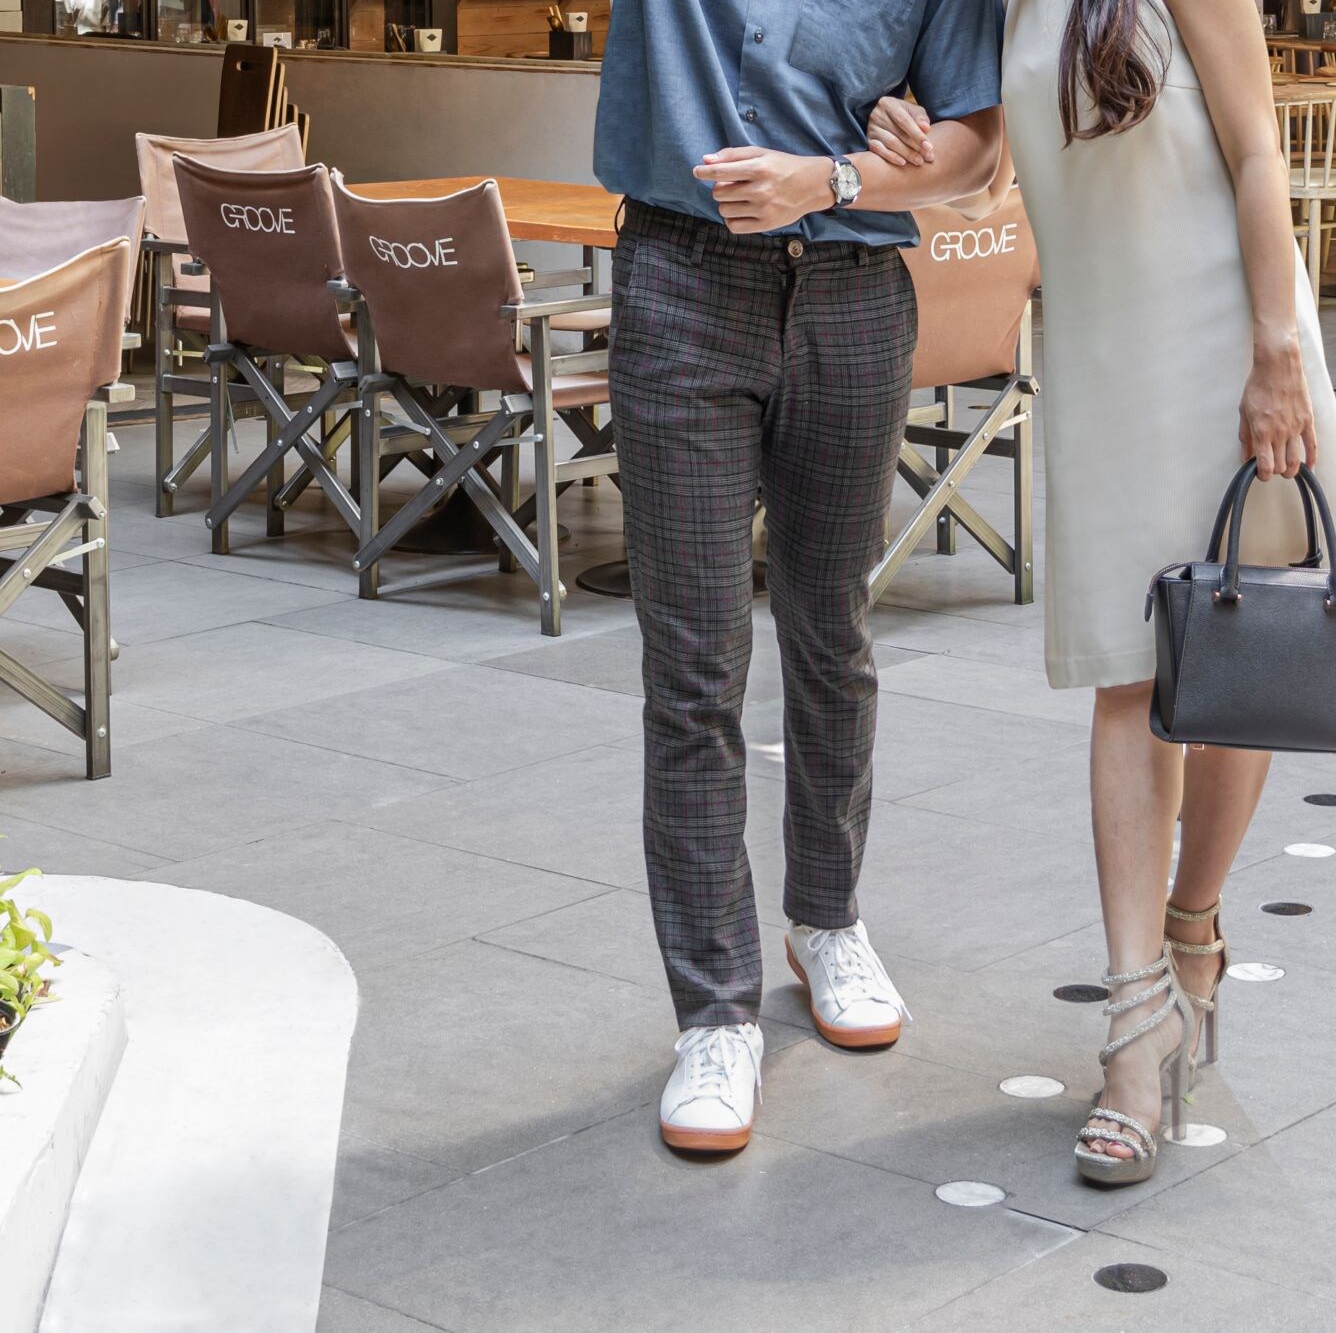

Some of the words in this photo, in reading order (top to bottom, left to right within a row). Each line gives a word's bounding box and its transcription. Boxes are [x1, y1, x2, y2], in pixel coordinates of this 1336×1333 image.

[220, 202, 296, 234] GROOVE
[368, 235, 458, 269] GROOVE
[928, 222, 1018, 262] GROOVE
